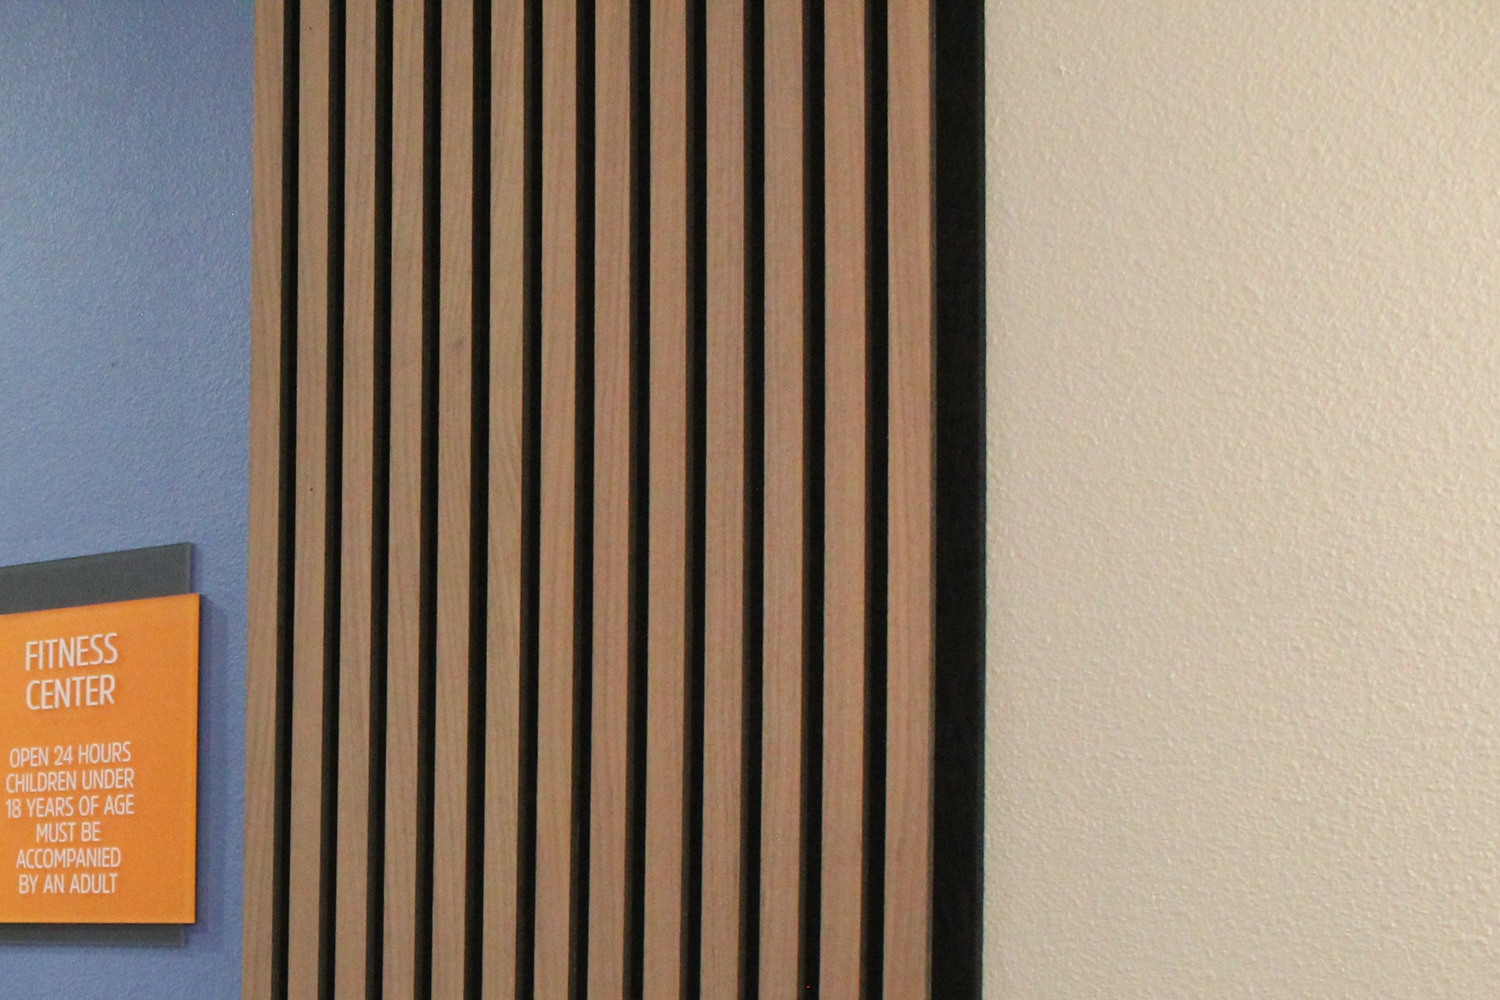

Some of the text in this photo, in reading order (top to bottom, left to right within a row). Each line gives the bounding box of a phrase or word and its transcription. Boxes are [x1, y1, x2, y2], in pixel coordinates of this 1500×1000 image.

[25, 632, 119, 672] FITNESS
[25, 673, 116, 711] CENTER
[9, 740, 132, 769] OPEN 24 HOURS
[5, 767, 135, 794] CHILDREN UNDER
[5, 793, 135, 819] 18 YEARS OF AGE
[36, 820, 101, 843] MUST BE
[15, 846, 122, 869] ACCOMPANIED
[18, 872, 119, 895] BY AN ADULT
